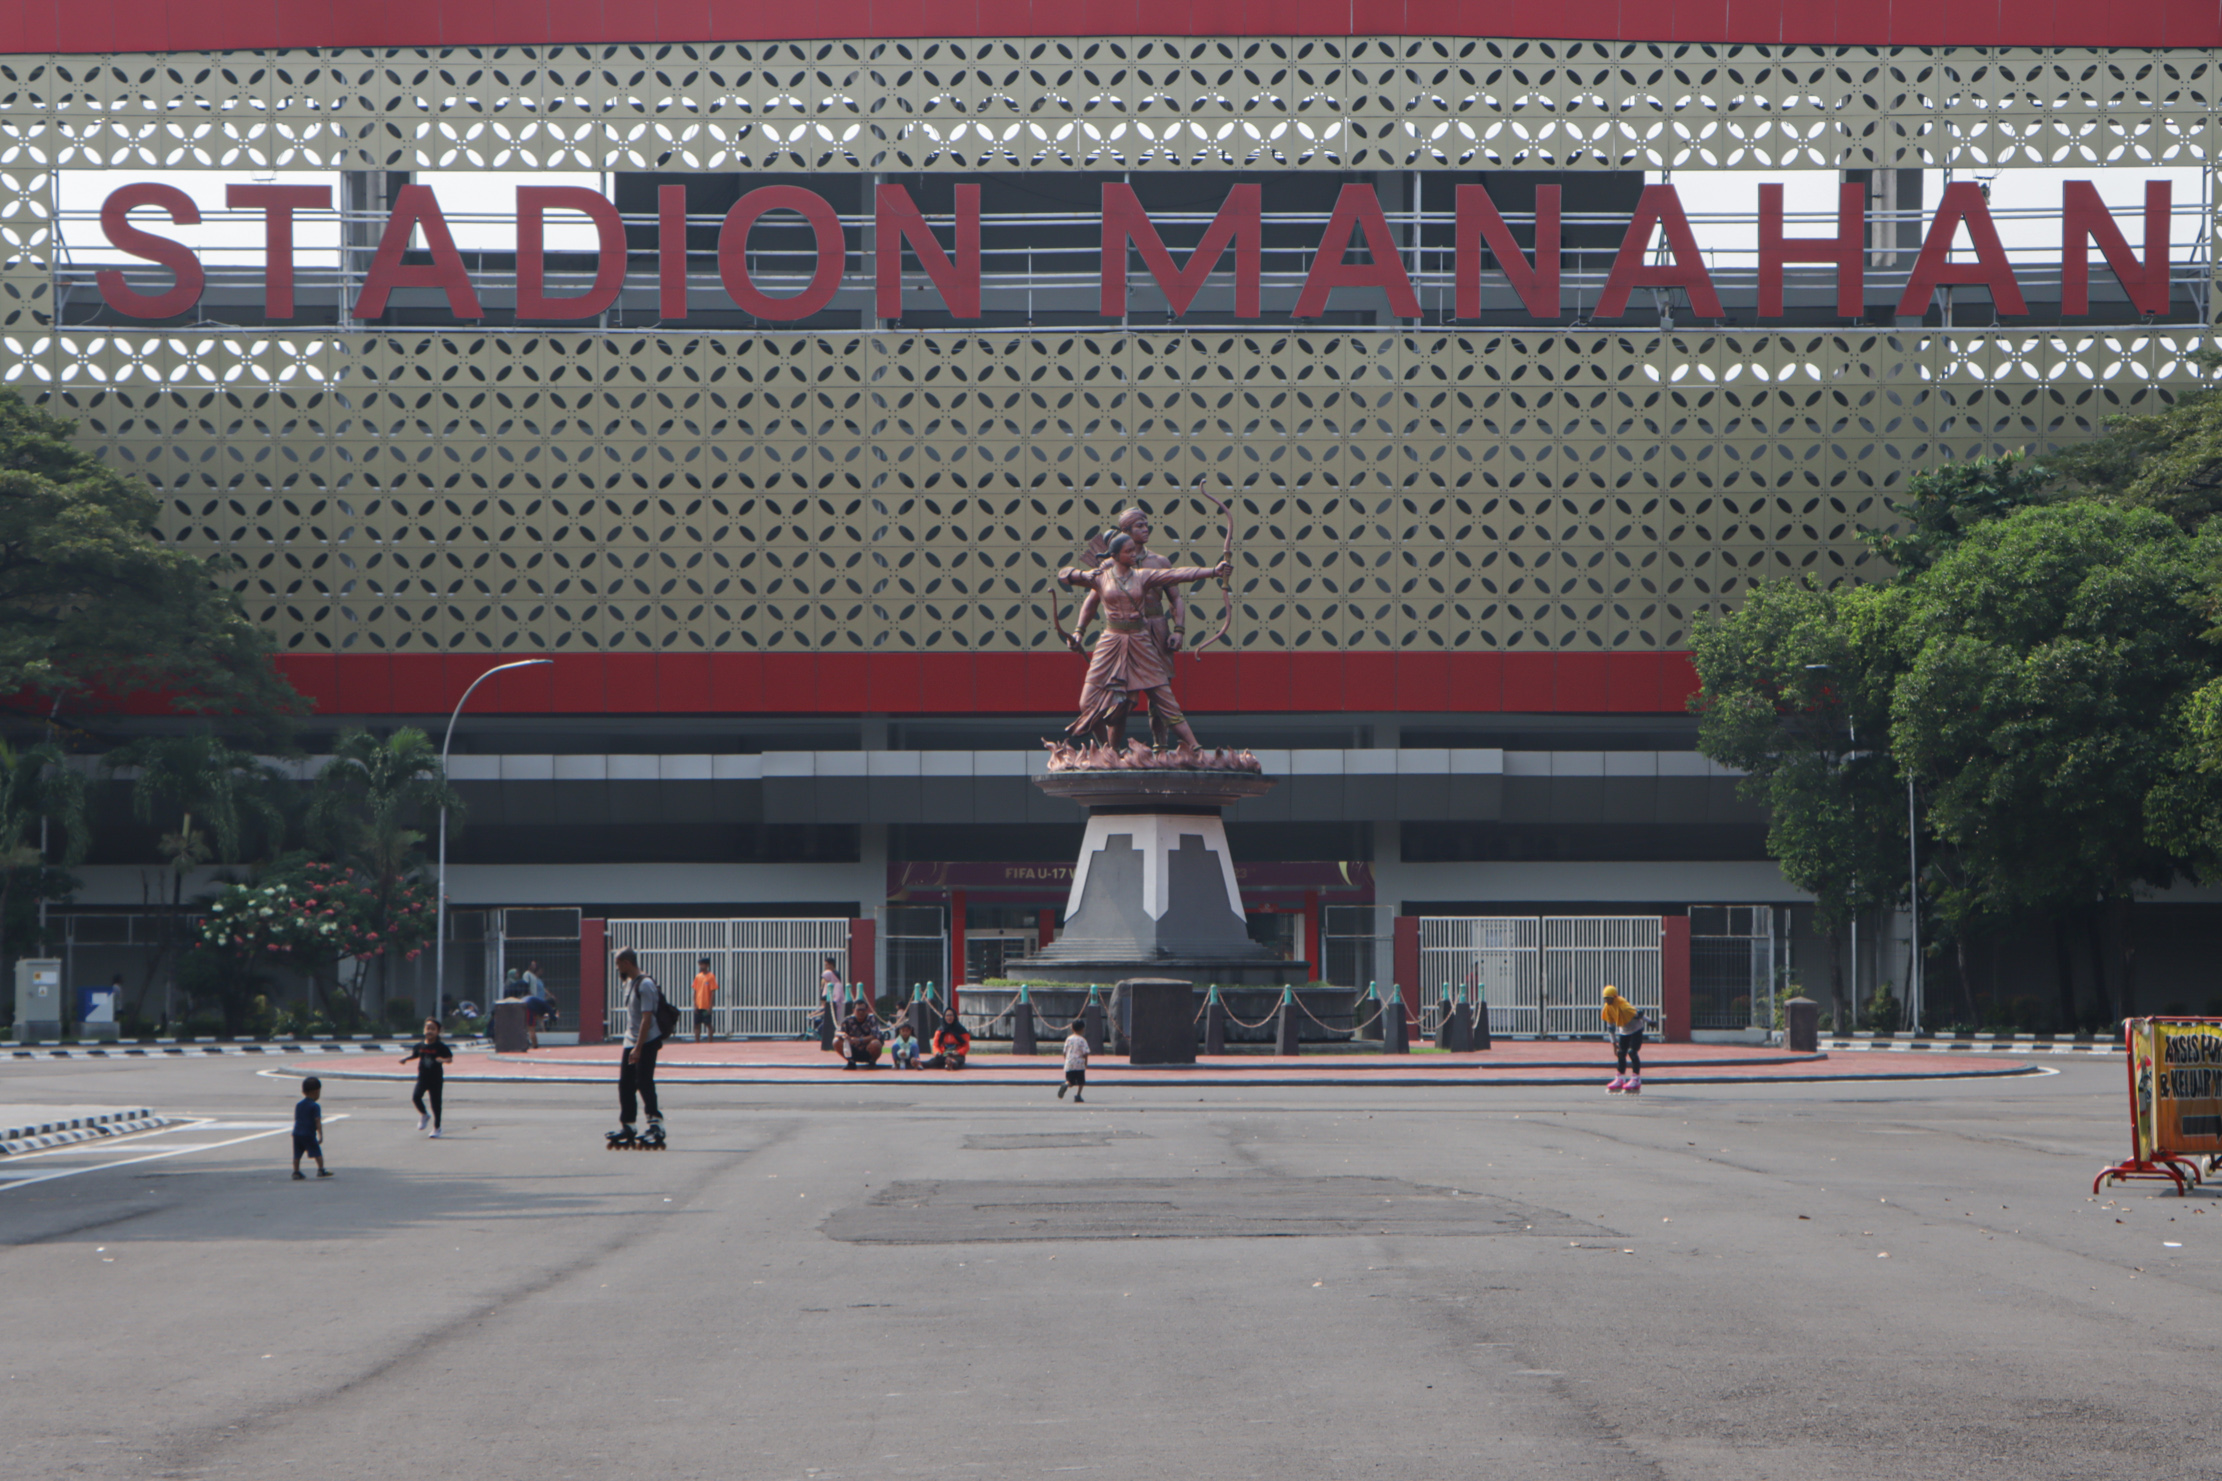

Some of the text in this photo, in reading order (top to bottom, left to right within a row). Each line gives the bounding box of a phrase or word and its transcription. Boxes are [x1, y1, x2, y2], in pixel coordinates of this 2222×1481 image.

[95, 179, 2172, 321] STADION MANAHAN
[1005, 867, 1036, 879] FIFA
[1037, 867, 1067, 879] U-17
[2171, 1069, 2212, 1098] KELUAR
